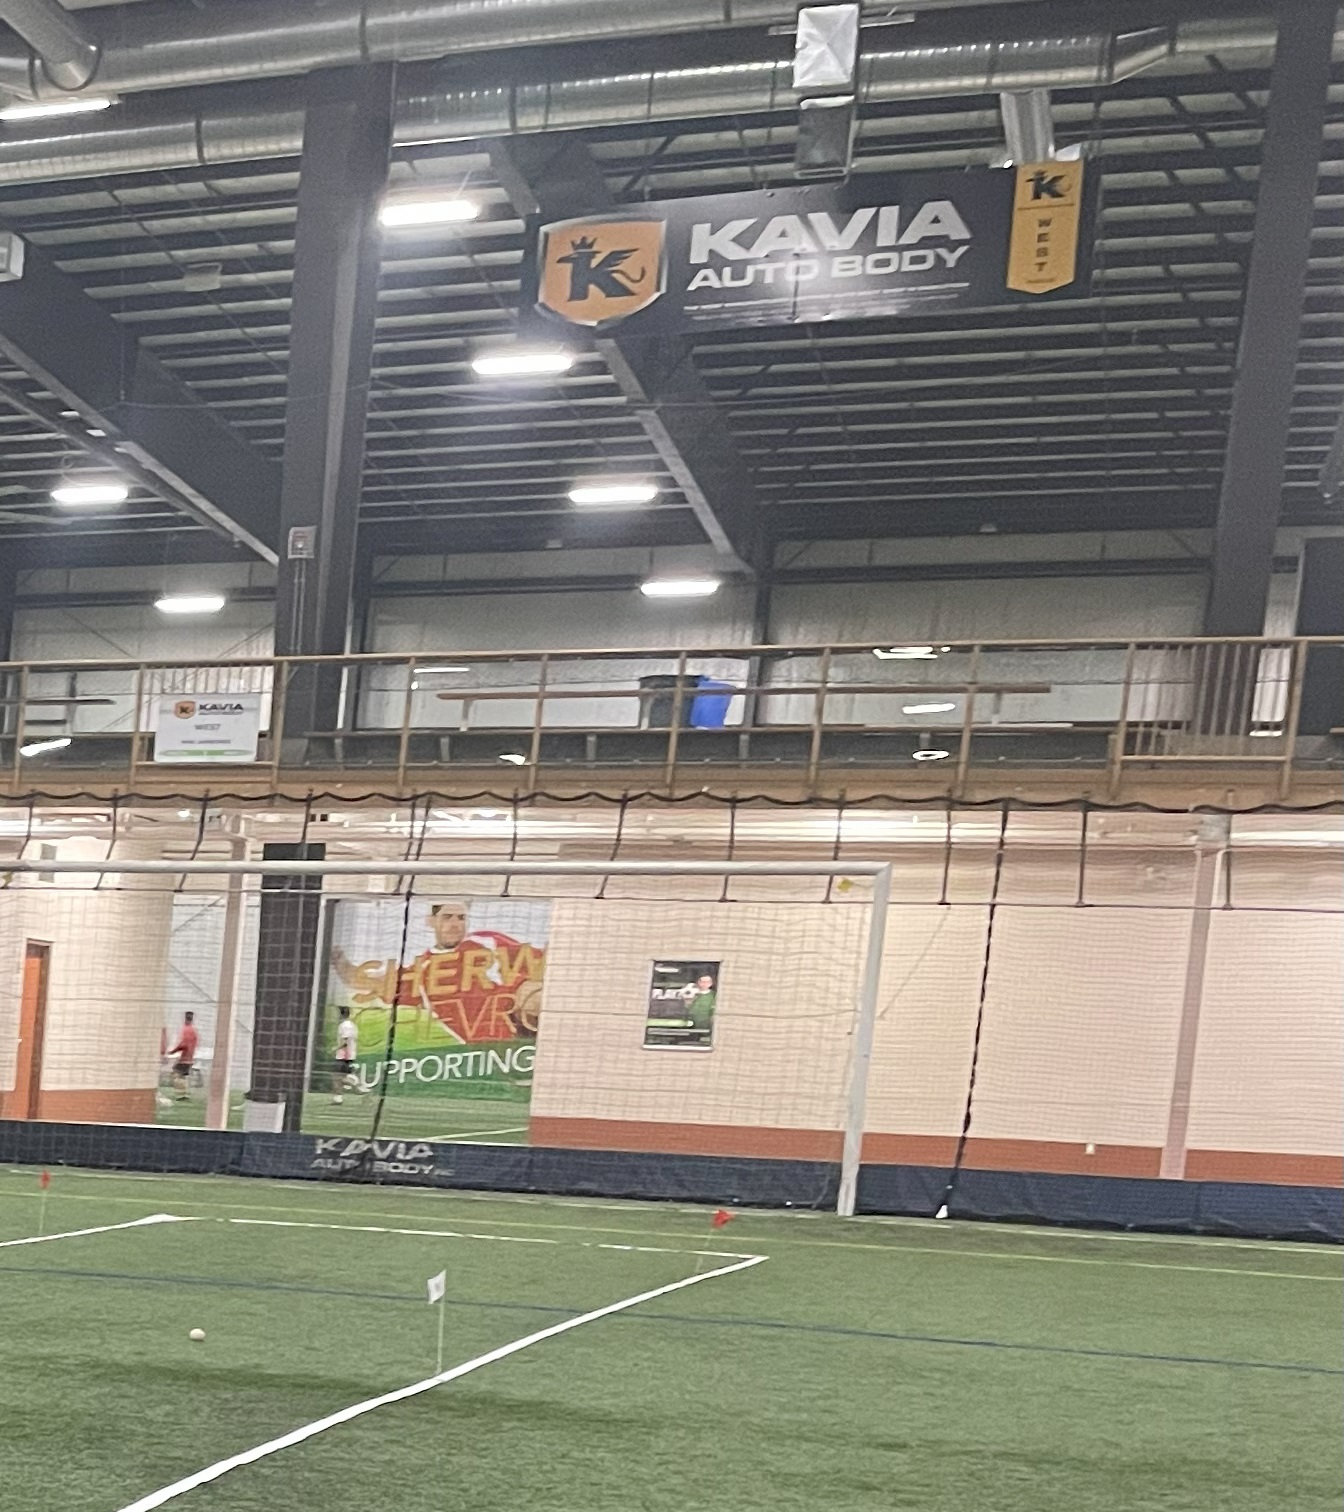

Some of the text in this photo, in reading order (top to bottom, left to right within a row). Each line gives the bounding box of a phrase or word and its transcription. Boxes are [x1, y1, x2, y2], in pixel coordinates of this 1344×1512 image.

[689, 200, 972, 264] KAVIA
[1034, 218, 1052, 272] WEST
[686, 245, 971, 291] AUTO BODY
[199, 703, 244, 711] KAVIA
[343, 1045, 536, 1092] SUPPORTING
